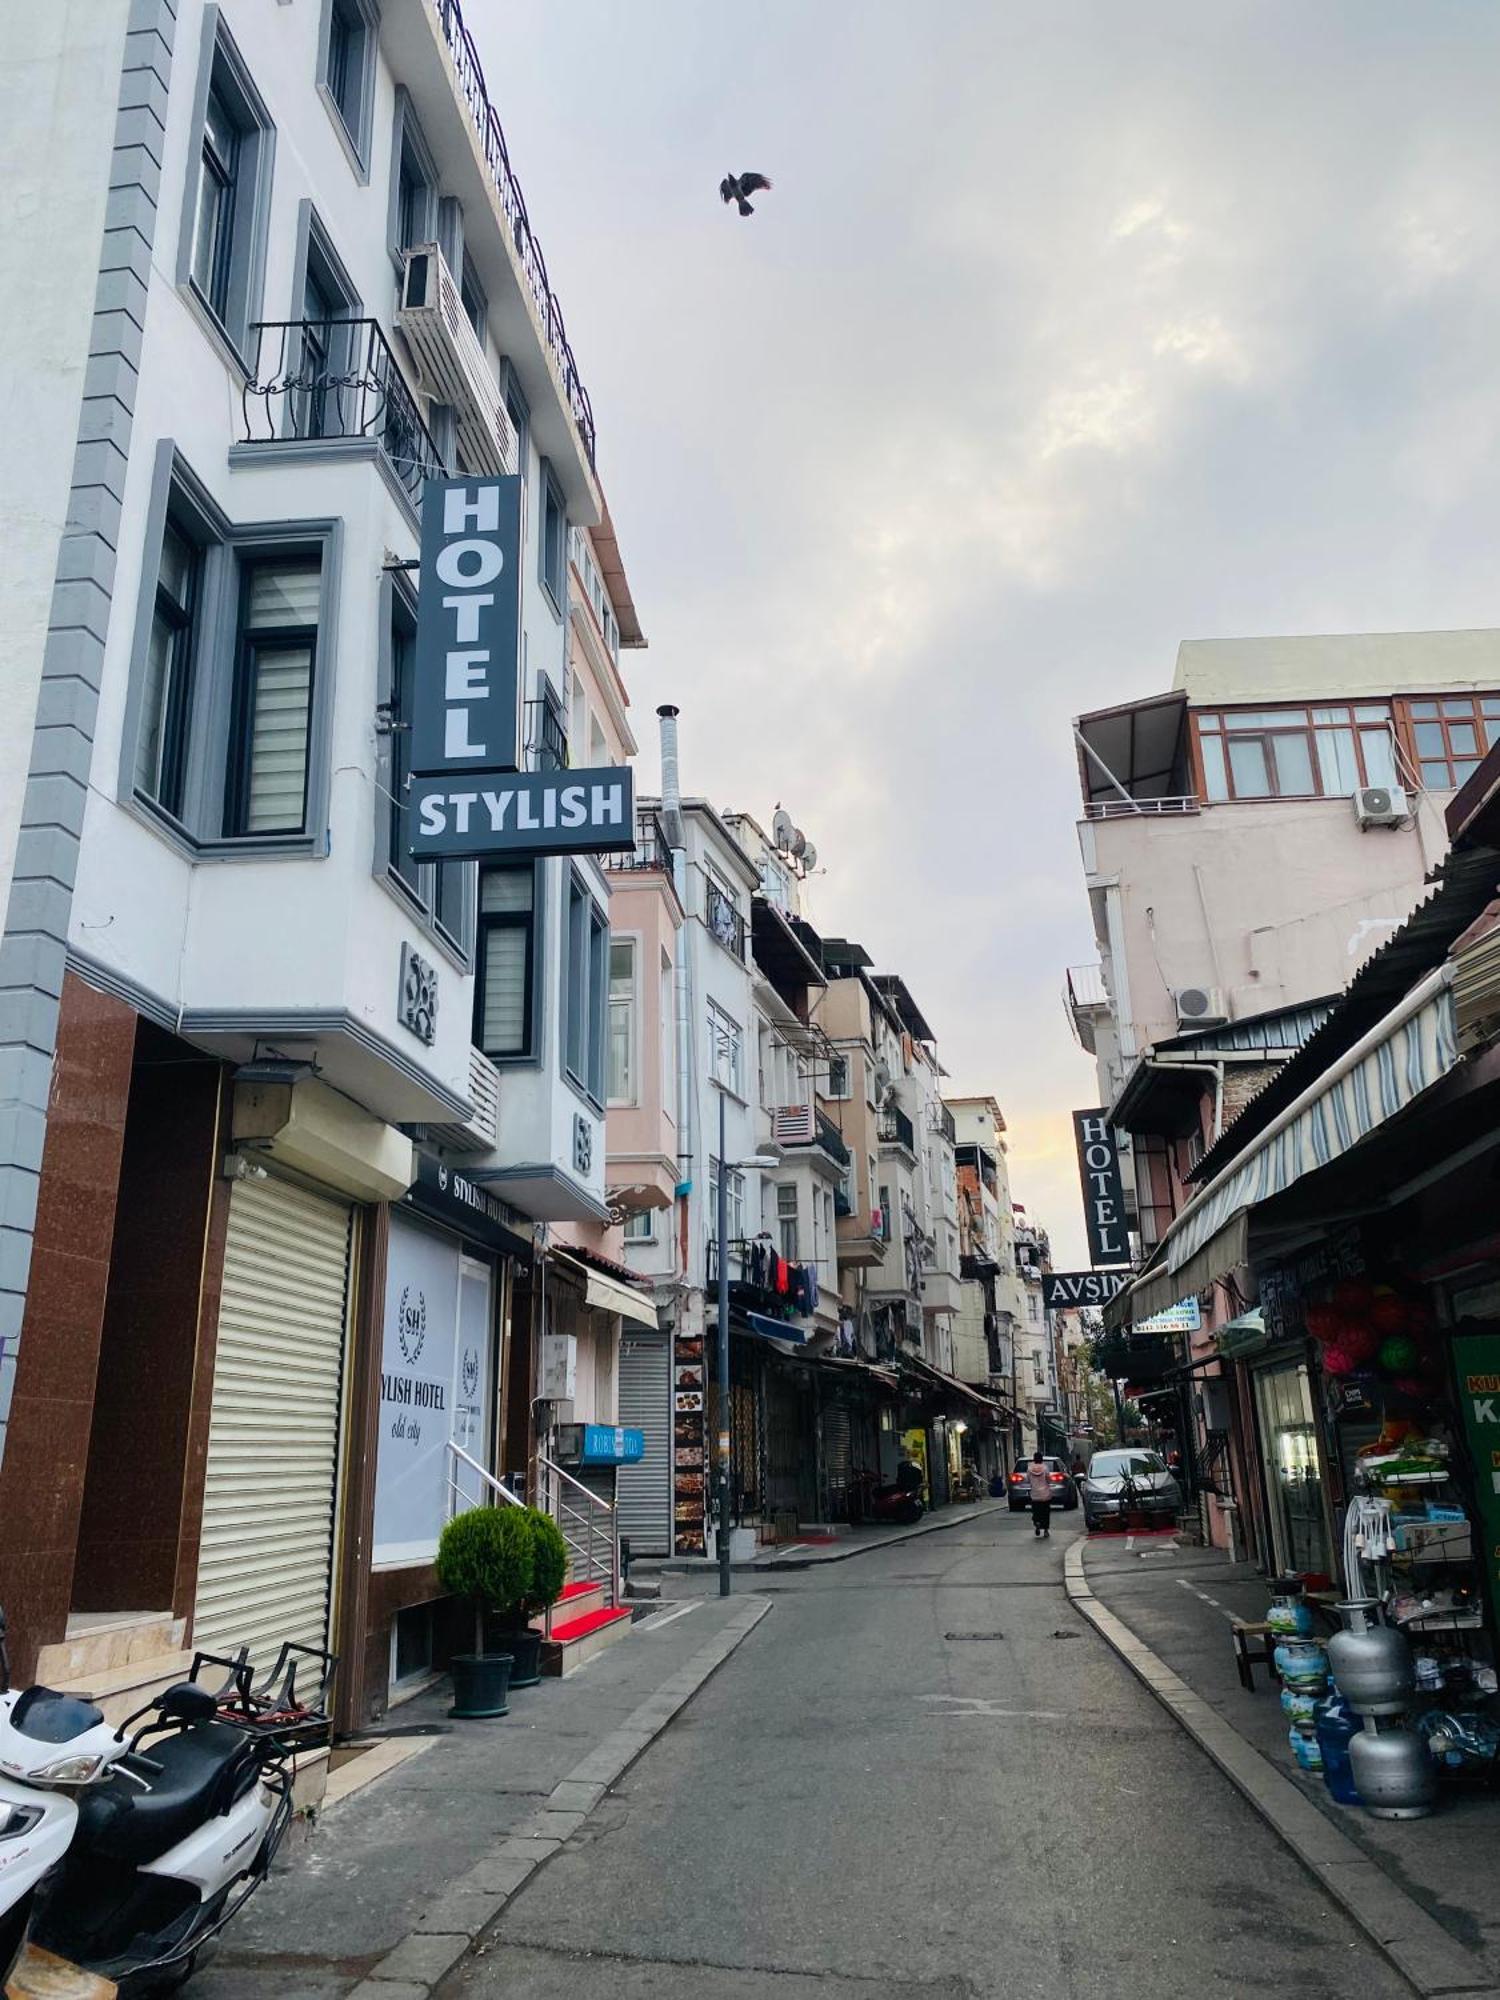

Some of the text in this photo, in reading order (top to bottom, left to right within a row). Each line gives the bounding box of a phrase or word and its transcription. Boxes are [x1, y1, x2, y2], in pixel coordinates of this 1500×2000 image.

[436, 486, 503, 758] HOTEL
[419, 784, 622, 836] STYLISH
[1081, 1118, 1122, 1253] HOTEL
[414, 1380, 445, 1410] HOTEL
